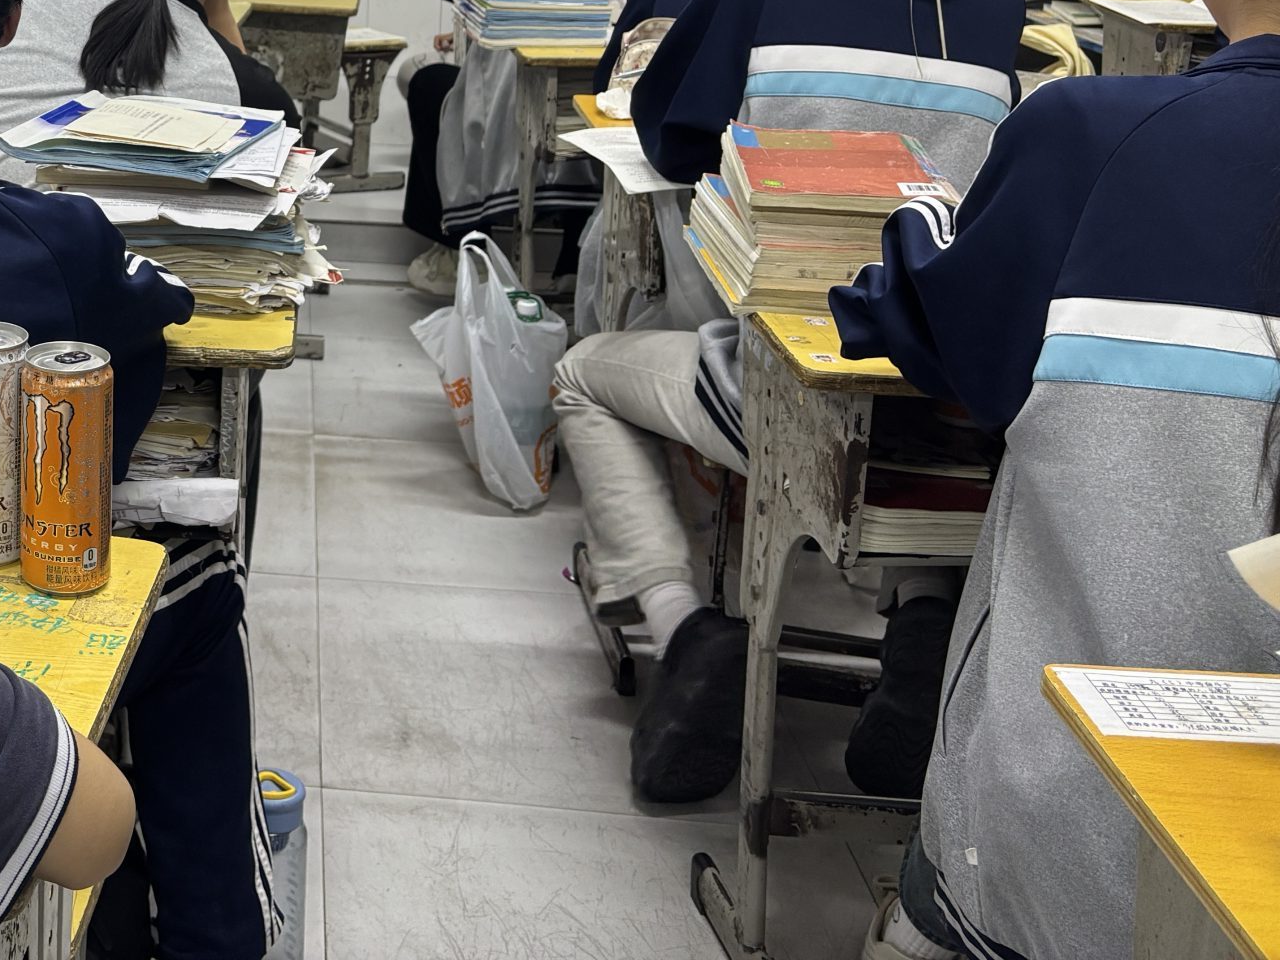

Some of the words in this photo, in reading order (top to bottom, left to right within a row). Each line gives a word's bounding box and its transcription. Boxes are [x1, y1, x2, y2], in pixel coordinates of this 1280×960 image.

[23, 514, 94, 538] NSTER
[34, 550, 82, 564] SUNRISE
[46, 572, 98, 585] 能量风味饮料
